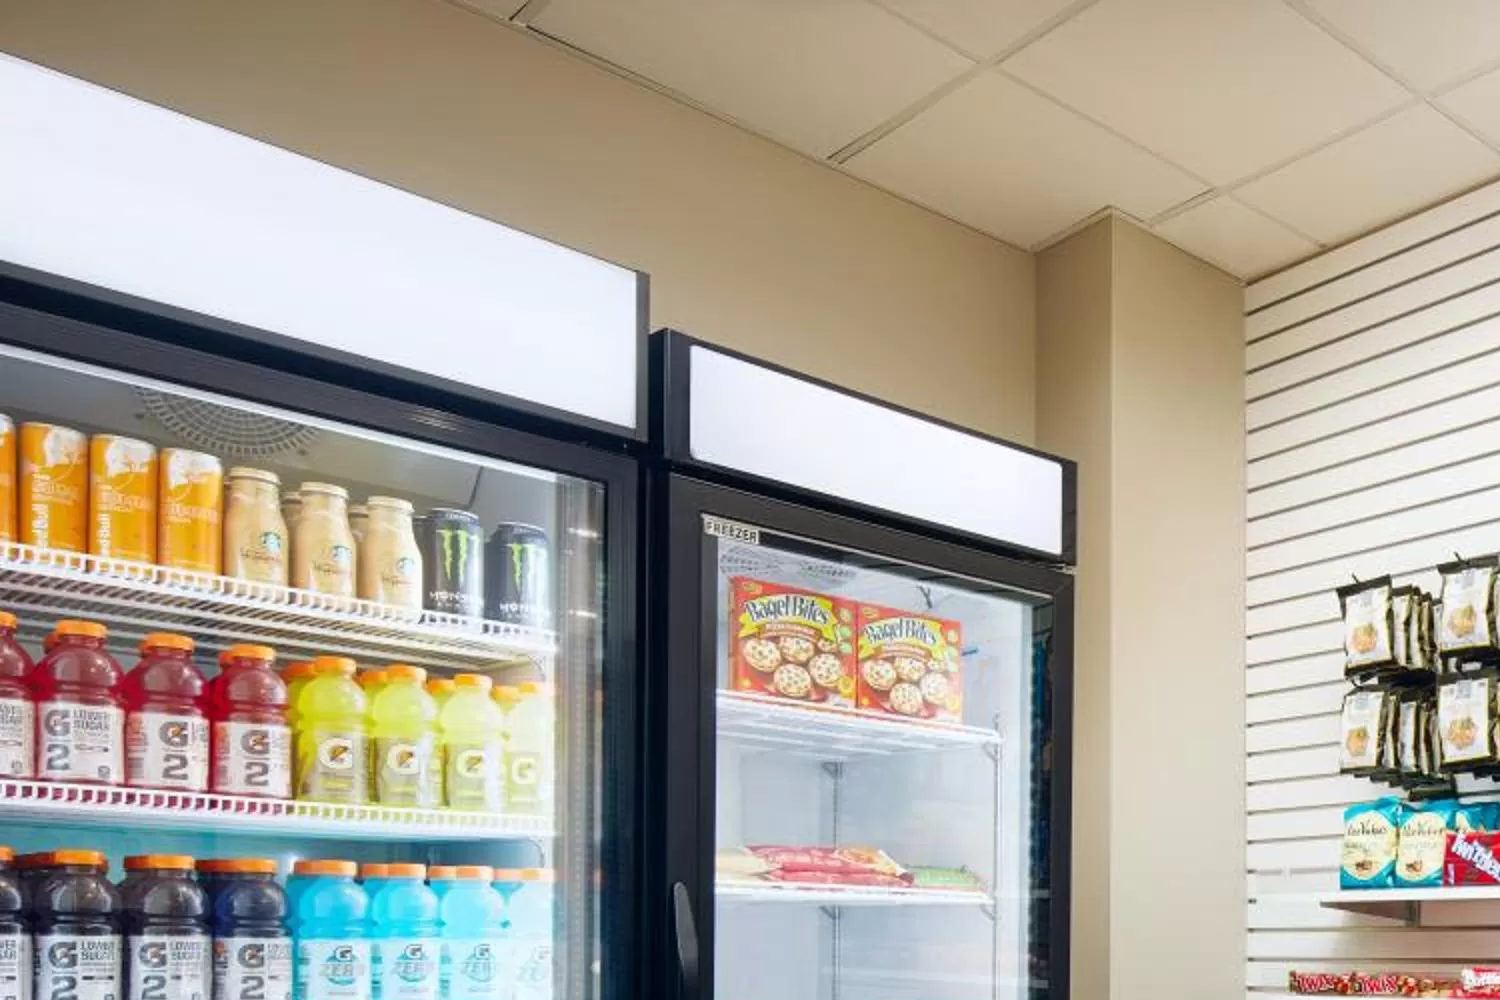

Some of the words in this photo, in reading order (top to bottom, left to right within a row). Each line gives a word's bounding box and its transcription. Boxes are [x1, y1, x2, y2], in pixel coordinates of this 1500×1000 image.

[706, 521, 757, 543] FREEZER
[744, 594, 789, 622] Bagel
[791, 595, 829, 625] Bites
[864, 617, 904, 645] Bagel
[905, 617, 938, 645] Bites
[44, 709, 71, 737] G
[160, 721, 189, 748] G
[240, 730, 270, 755] G
[318, 738, 353, 769] G
[46, 743, 71, 771] 2
[162, 753, 189, 781] 2
[244, 761, 269, 786] 2
[48, 941, 78, 969] G
[138, 941, 167, 969] G
[237, 943, 265, 969] G
[141, 975, 167, 1000] 2
[239, 975, 265, 1000] 2
[1360, 976, 1399, 994] TWIX
